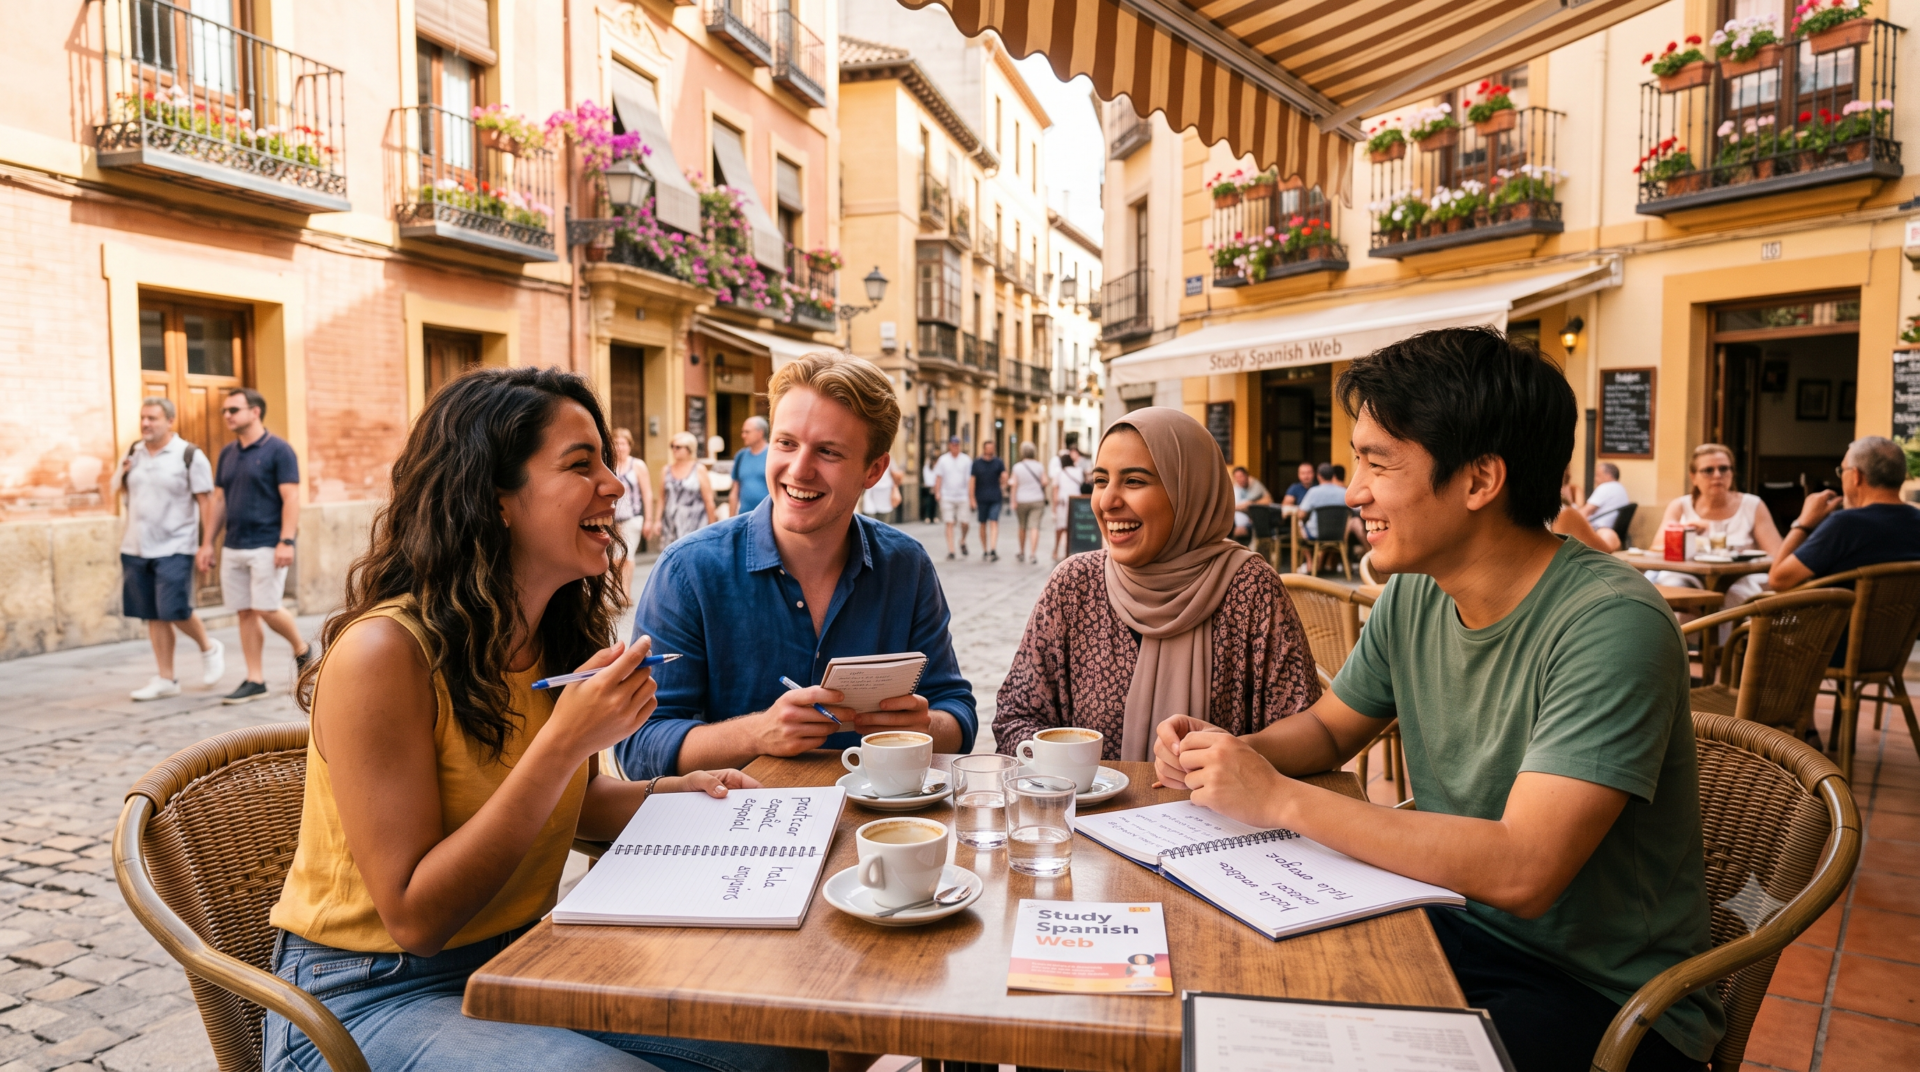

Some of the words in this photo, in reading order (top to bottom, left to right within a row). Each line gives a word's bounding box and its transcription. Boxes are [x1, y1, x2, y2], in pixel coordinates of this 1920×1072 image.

[1209, 352, 1245, 372] Study
[1249, 343, 1303, 369] Spanish
[1308, 338, 1342, 358] Web
[1038, 909, 1112, 924] Study
[1036, 922, 1139, 935] Spanish
[1035, 935, 1094, 948] Web
